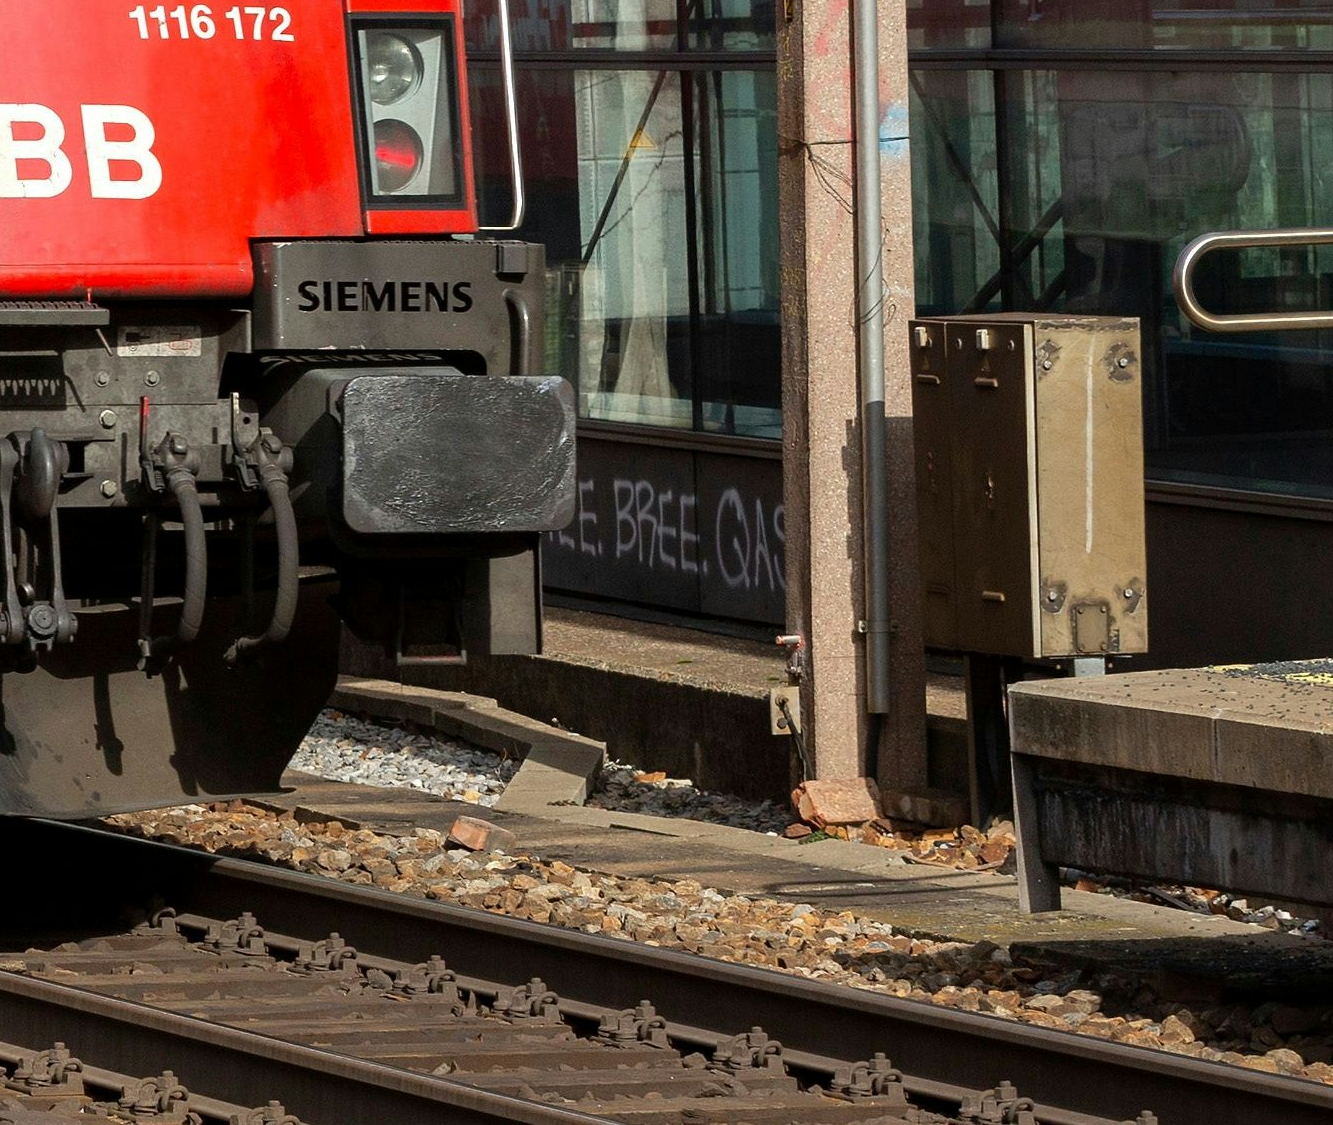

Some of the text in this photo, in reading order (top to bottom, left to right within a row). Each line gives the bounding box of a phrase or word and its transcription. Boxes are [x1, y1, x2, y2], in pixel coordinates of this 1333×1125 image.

[128, 4, 295, 42] 1116 172
[297, 280, 474, 313] SIEMENS
